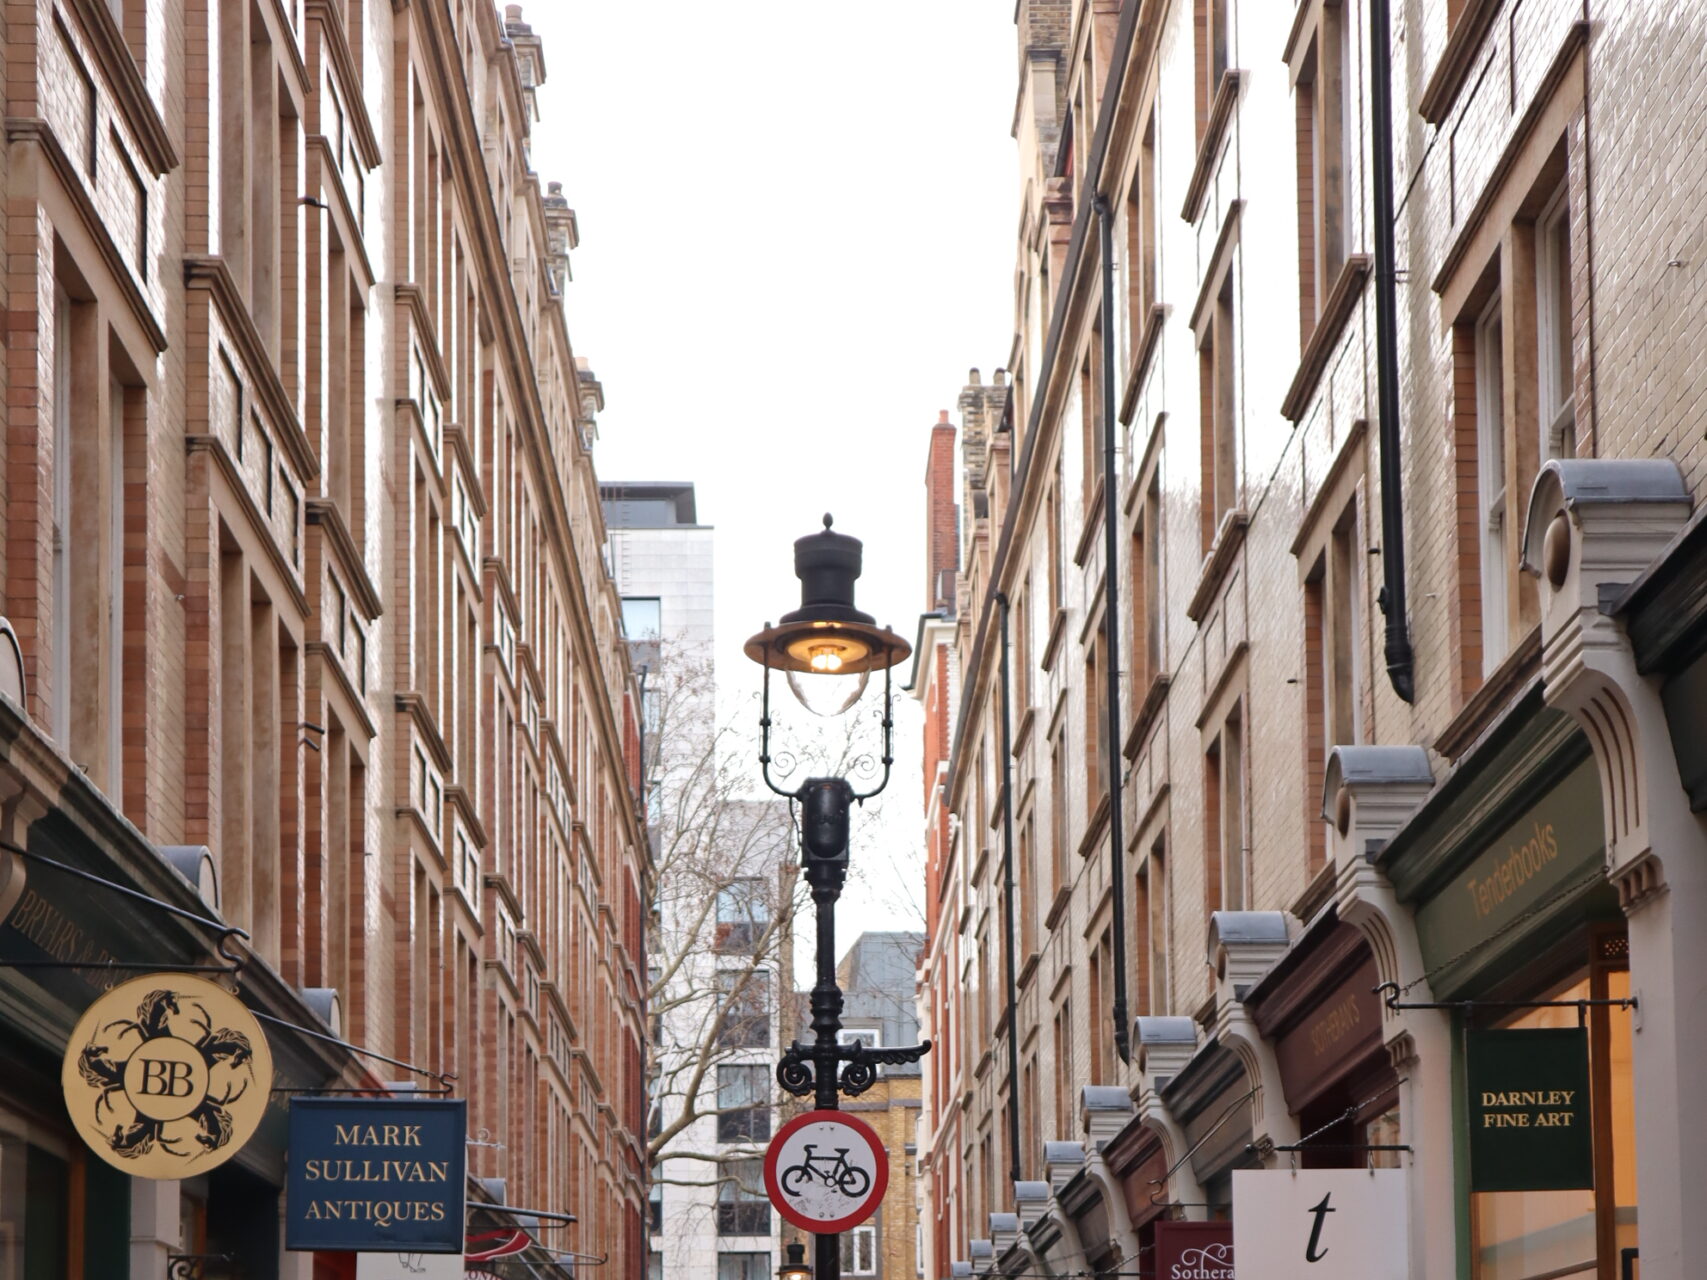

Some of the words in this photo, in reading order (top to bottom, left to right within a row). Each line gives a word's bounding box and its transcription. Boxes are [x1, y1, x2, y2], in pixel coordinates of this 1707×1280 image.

[1466, 822, 1558, 920] Tenderbooks
[136, 1058, 194, 1098] BB
[1481, 1090, 1576, 1107] DARNLEY
[1483, 1112, 1530, 1128] FINE
[1534, 1112, 1575, 1127] ART
[334, 1124, 422, 1147] MARK
[305, 1159, 449, 1183] SULLIVAN
[304, 1200, 445, 1227] ANTIQUES
[1305, 1191, 1336, 1264] t
